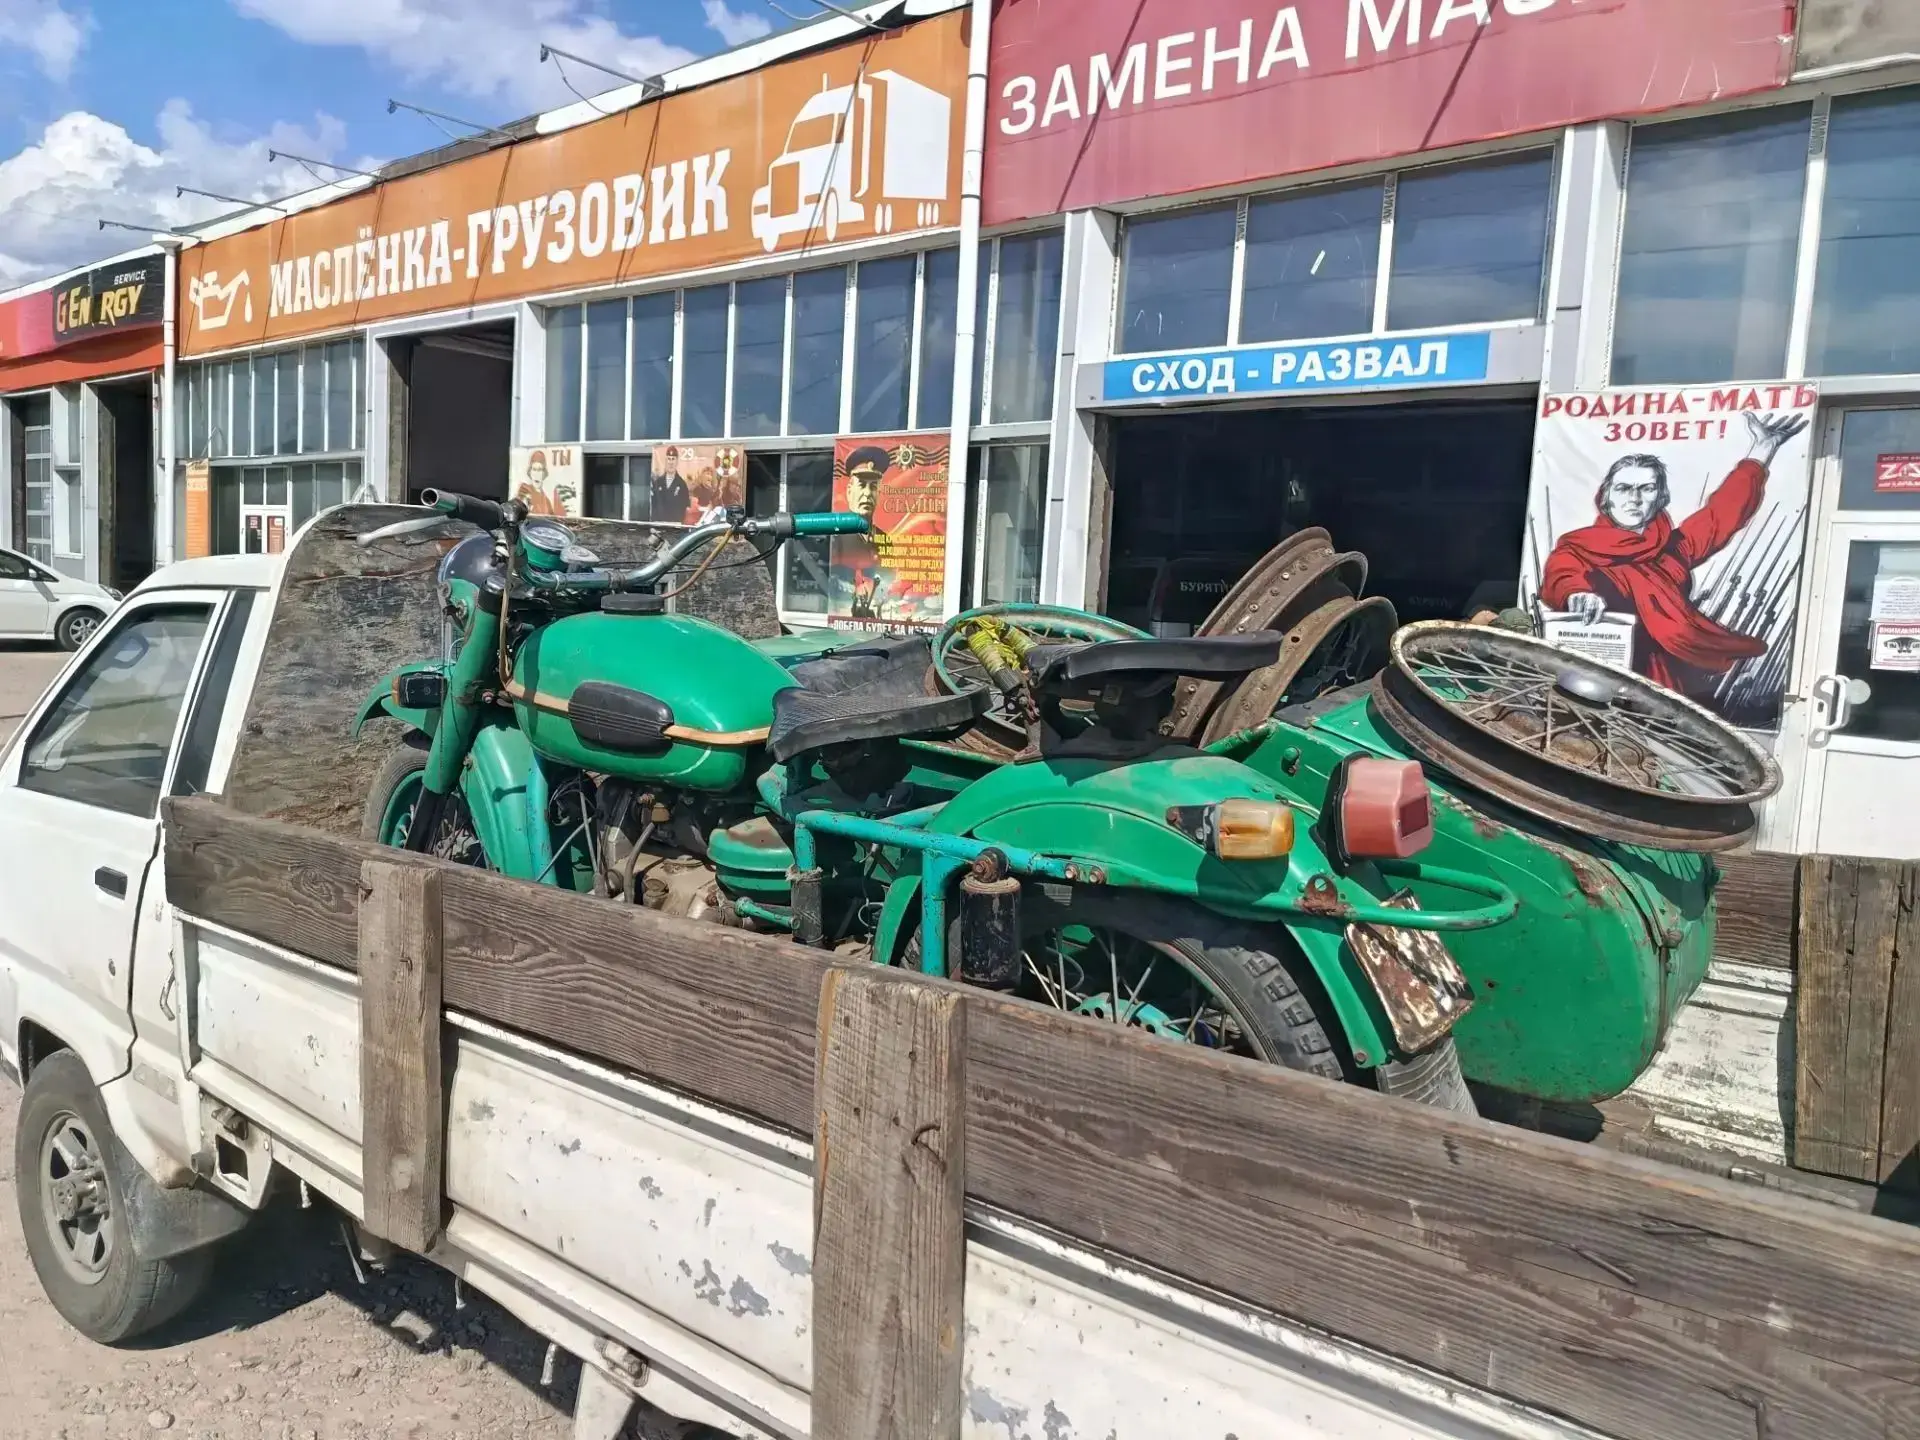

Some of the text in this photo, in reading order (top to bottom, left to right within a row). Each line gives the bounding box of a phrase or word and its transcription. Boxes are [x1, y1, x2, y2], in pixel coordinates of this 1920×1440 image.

[1000, 7, 1311, 136] ЗАМЕНА
[270, 148, 731, 318] МАСЛЁНКА-ГРУЗОВИК
[113, 270, 147, 285] SERVICE
[1132, 356, 1236, 394] СХОД
[1272, 341, 1449, 384] РАЗВАЛ
[1541, 384, 1818, 419] РОДИНА-МАТЬ
[1603, 420, 1728, 442] ЗОВЕТ!
[552, 449, 571, 466] ТЫ
